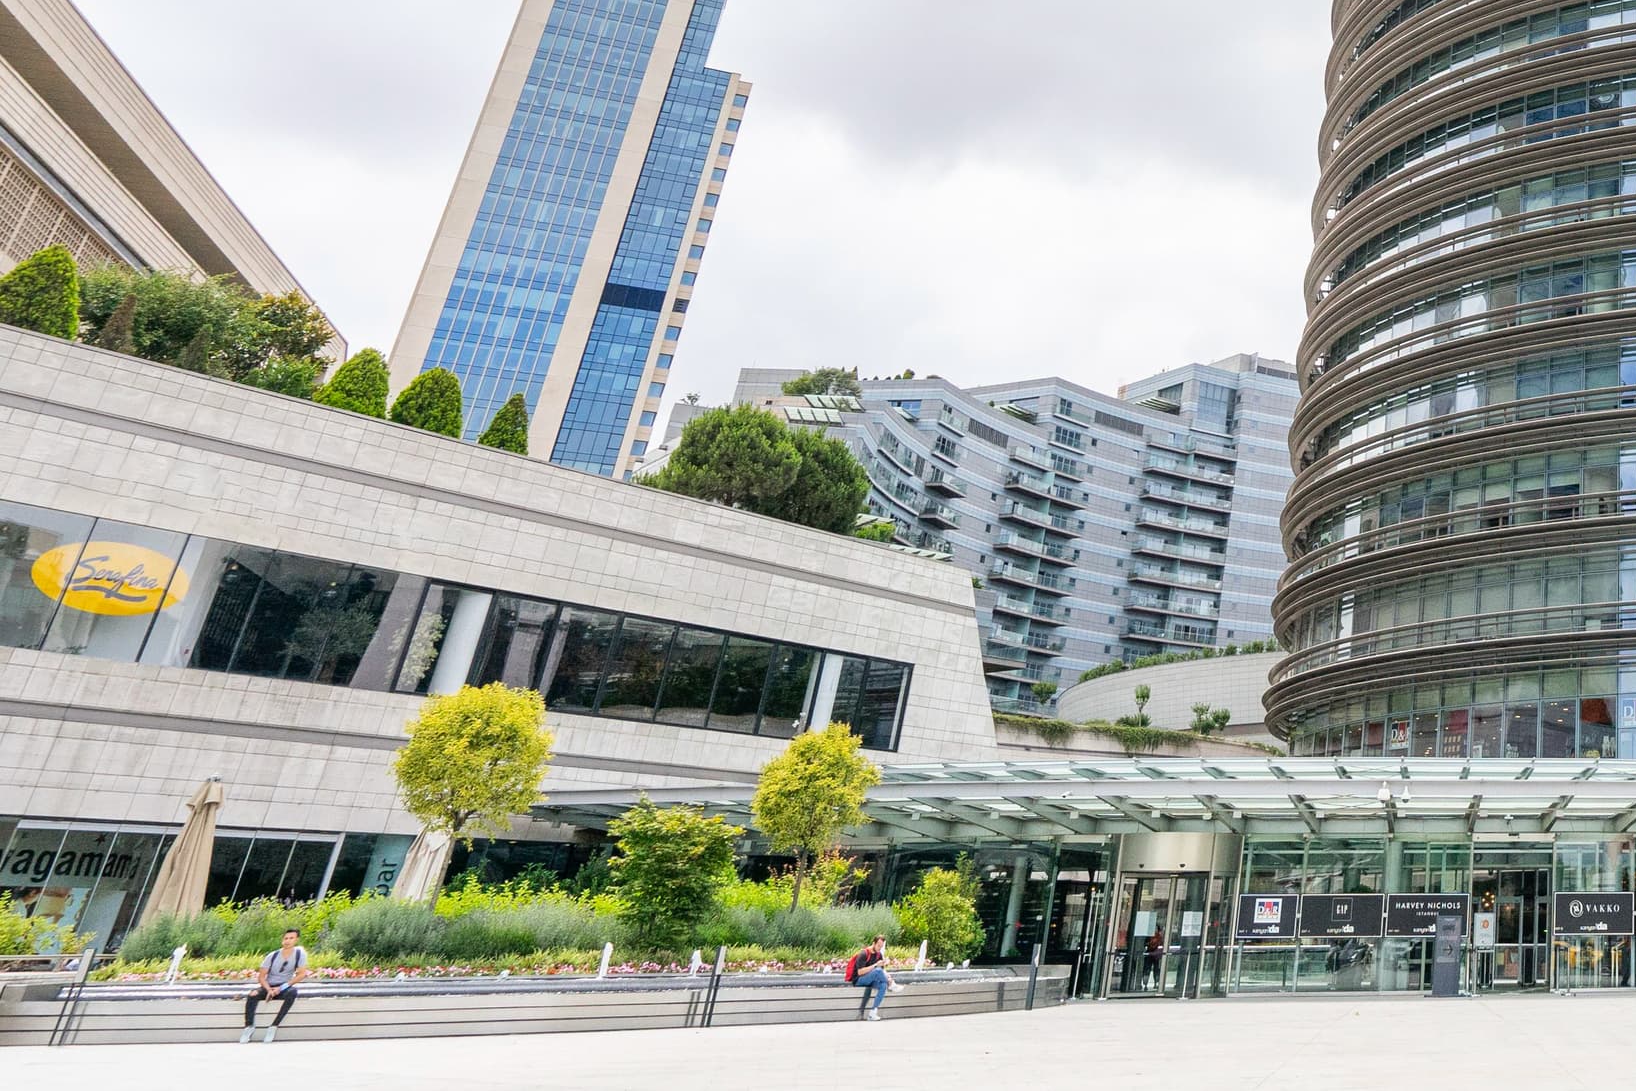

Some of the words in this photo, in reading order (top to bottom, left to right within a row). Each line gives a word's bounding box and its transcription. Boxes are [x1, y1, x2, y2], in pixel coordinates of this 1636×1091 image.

[65, 555, 159, 598] Serafina
[1395, 902, 1425, 910] HARVEY
[1427, 901, 1461, 909] NICHOLS
[1586, 903, 1620, 913] VAKKO
